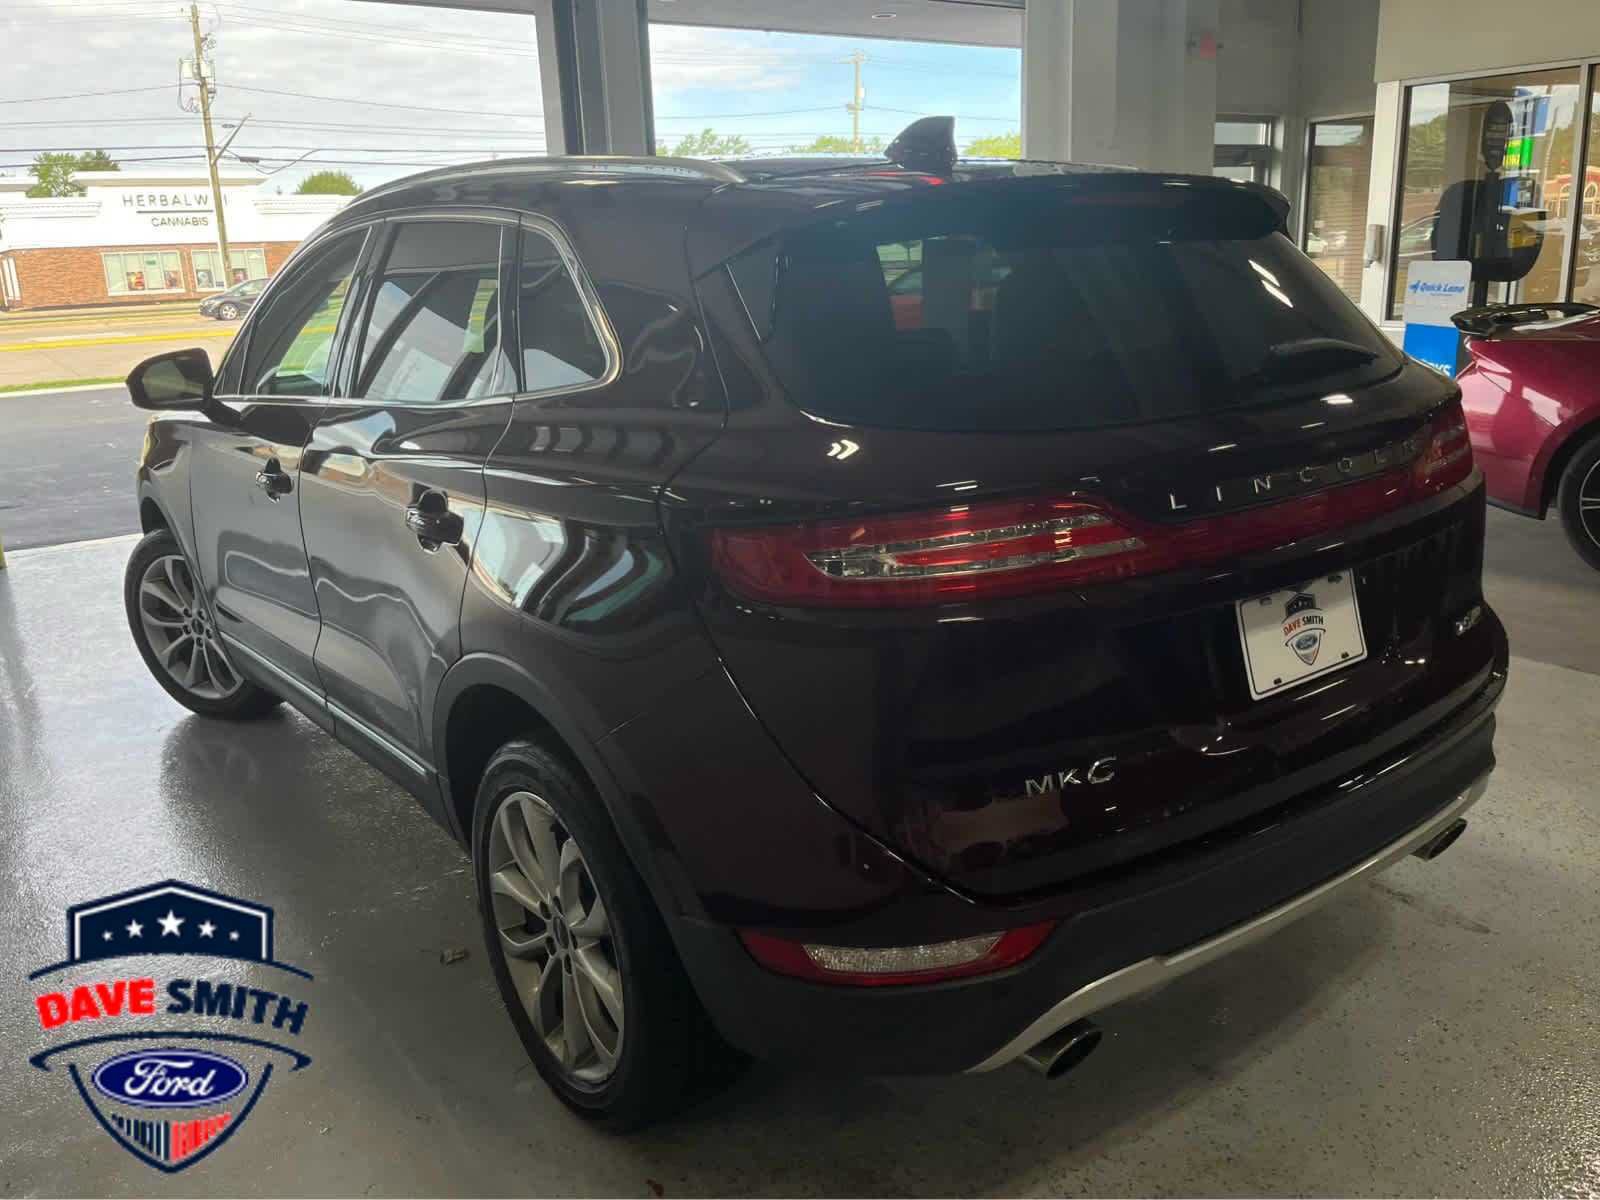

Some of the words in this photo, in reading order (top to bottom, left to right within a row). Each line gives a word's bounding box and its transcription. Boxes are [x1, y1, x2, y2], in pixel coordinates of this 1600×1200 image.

[151, 216, 209, 227] CANNABIS
[1420, 281, 1443, 293] Quick
[1443, 282, 1465, 294] Lane
[1169, 439, 1417, 510] LINCOLN
[1283, 616, 1301, 636] DAVE
[1302, 615, 1324, 626] SMITH
[1025, 756, 1117, 798] MKC
